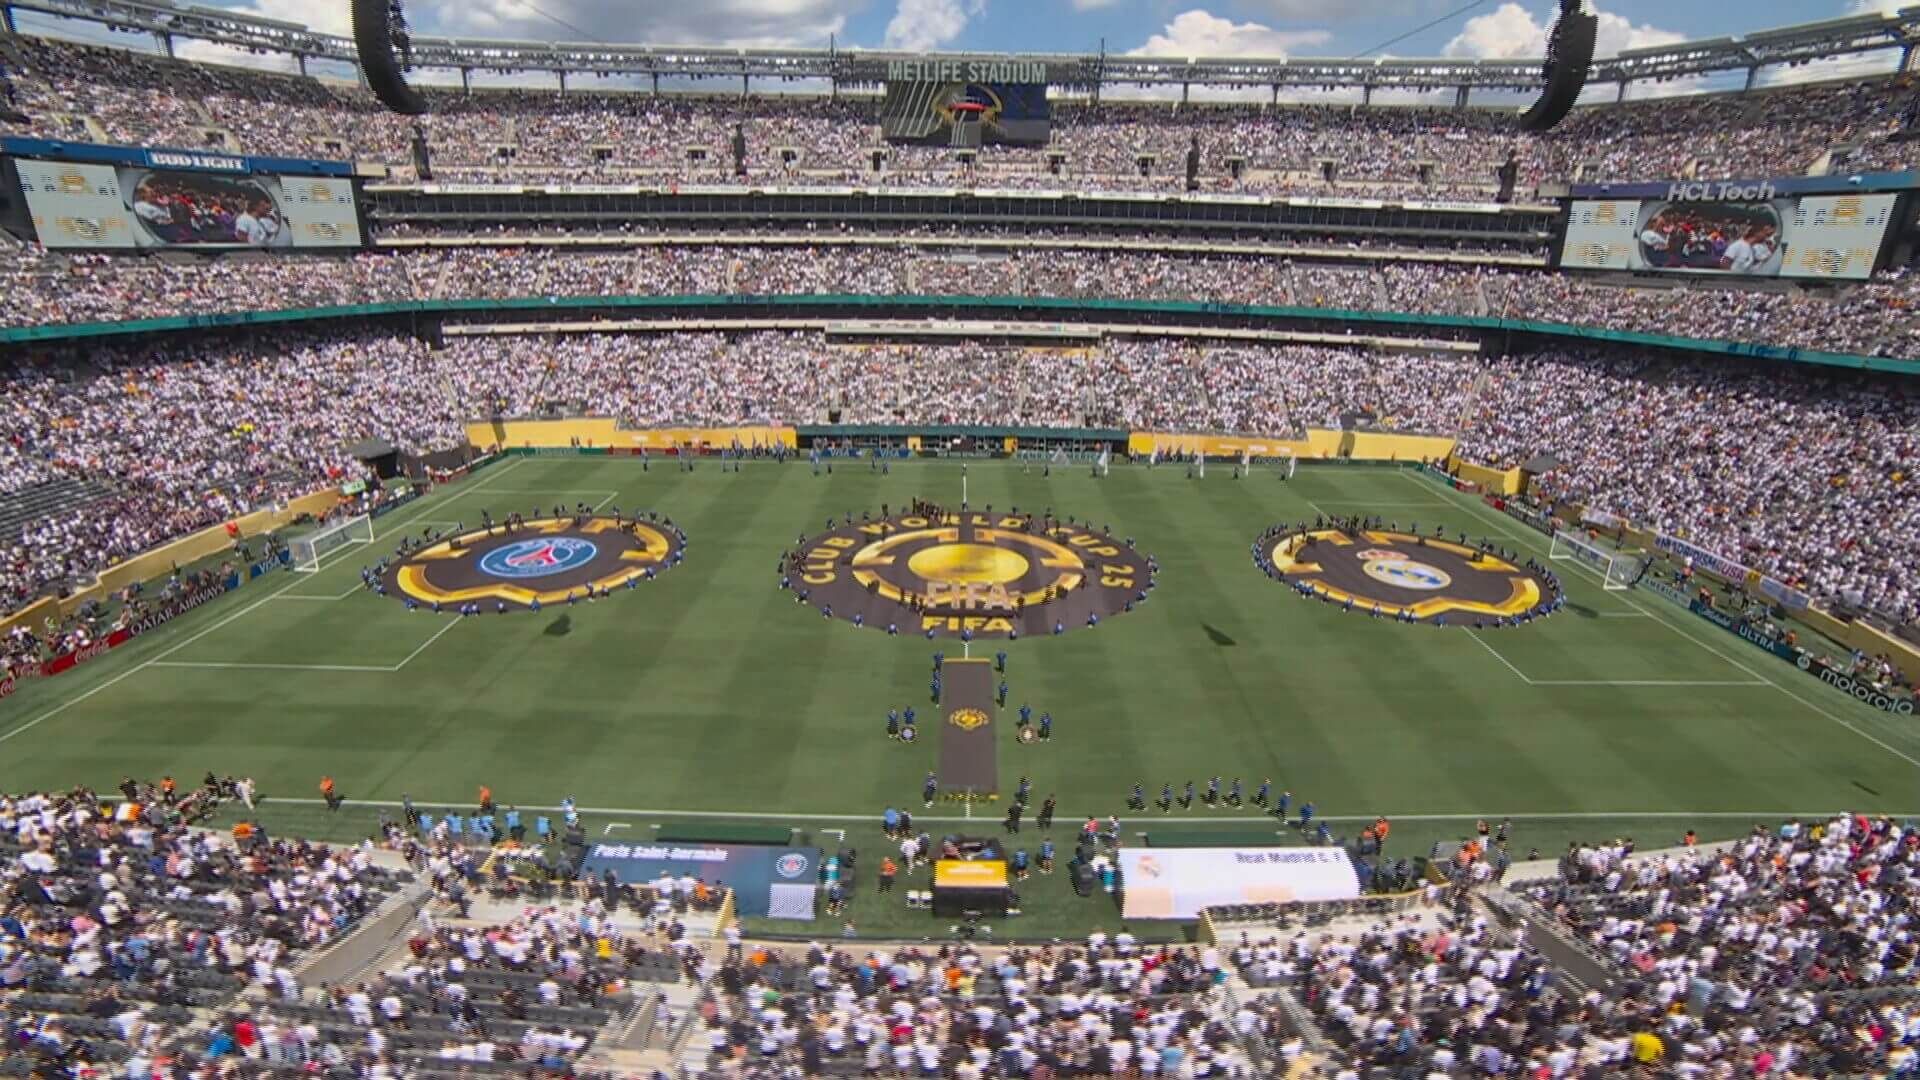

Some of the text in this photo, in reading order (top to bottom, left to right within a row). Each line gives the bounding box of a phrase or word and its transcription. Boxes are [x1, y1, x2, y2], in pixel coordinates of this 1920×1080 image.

[888, 61, 1046, 83] METLIFE STADIUM
[150, 151, 244, 170] BUD LIGHT
[1667, 181, 1776, 200] HCLTech
[802, 514, 1135, 589] CLUB WORLD CUP 25
[927, 582, 1013, 610] FIFA
[131, 583, 225, 636] QATAR AIRWAYS
[922, 616, 1013, 632] FIFA
[1739, 625, 1775, 651] ULTRA
[1820, 668, 1915, 715] motorola
[593, 843, 728, 861] Paris Saint-Germain
[1235, 852, 1264, 863] Real
[1267, 852, 1315, 864] Madrid
